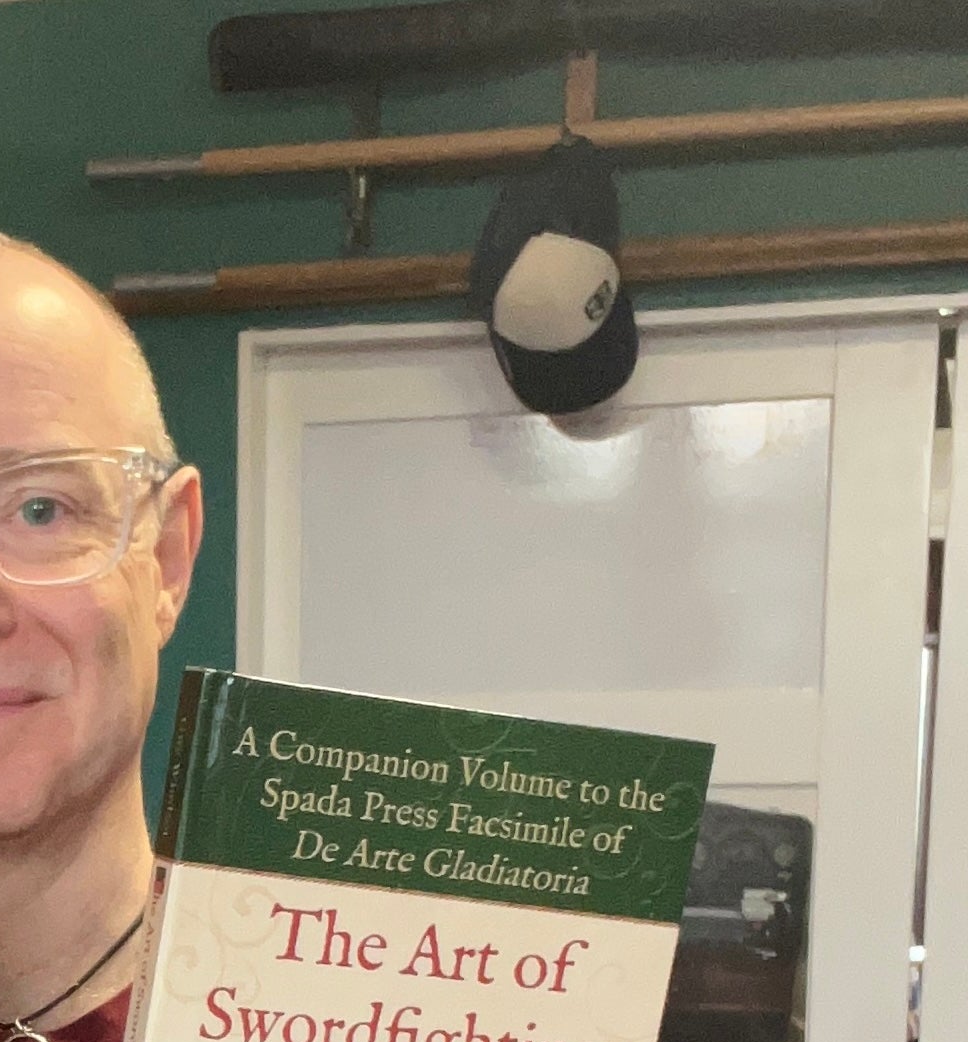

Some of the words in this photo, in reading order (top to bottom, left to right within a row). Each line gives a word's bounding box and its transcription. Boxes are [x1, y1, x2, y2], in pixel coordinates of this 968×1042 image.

[233, 726, 259, 758] A
[269, 730, 449, 783] Companion
[459, 756, 571, 799] Volume
[579, 777, 610, 805] to
[619, 779, 666, 813] the
[261, 777, 352, 821] Spada
[360, 791, 438, 829] Press
[446, 803, 585, 848] Facsimile
[592, 825, 632, 855] of
[292, 830, 340, 863] De
[343, 838, 415, 873] Arte
[424, 847, 591, 896] Gladiatoria
[270, 902, 387, 971] The
[399, 923, 499, 985] Art
[513, 939, 590, 993] of
